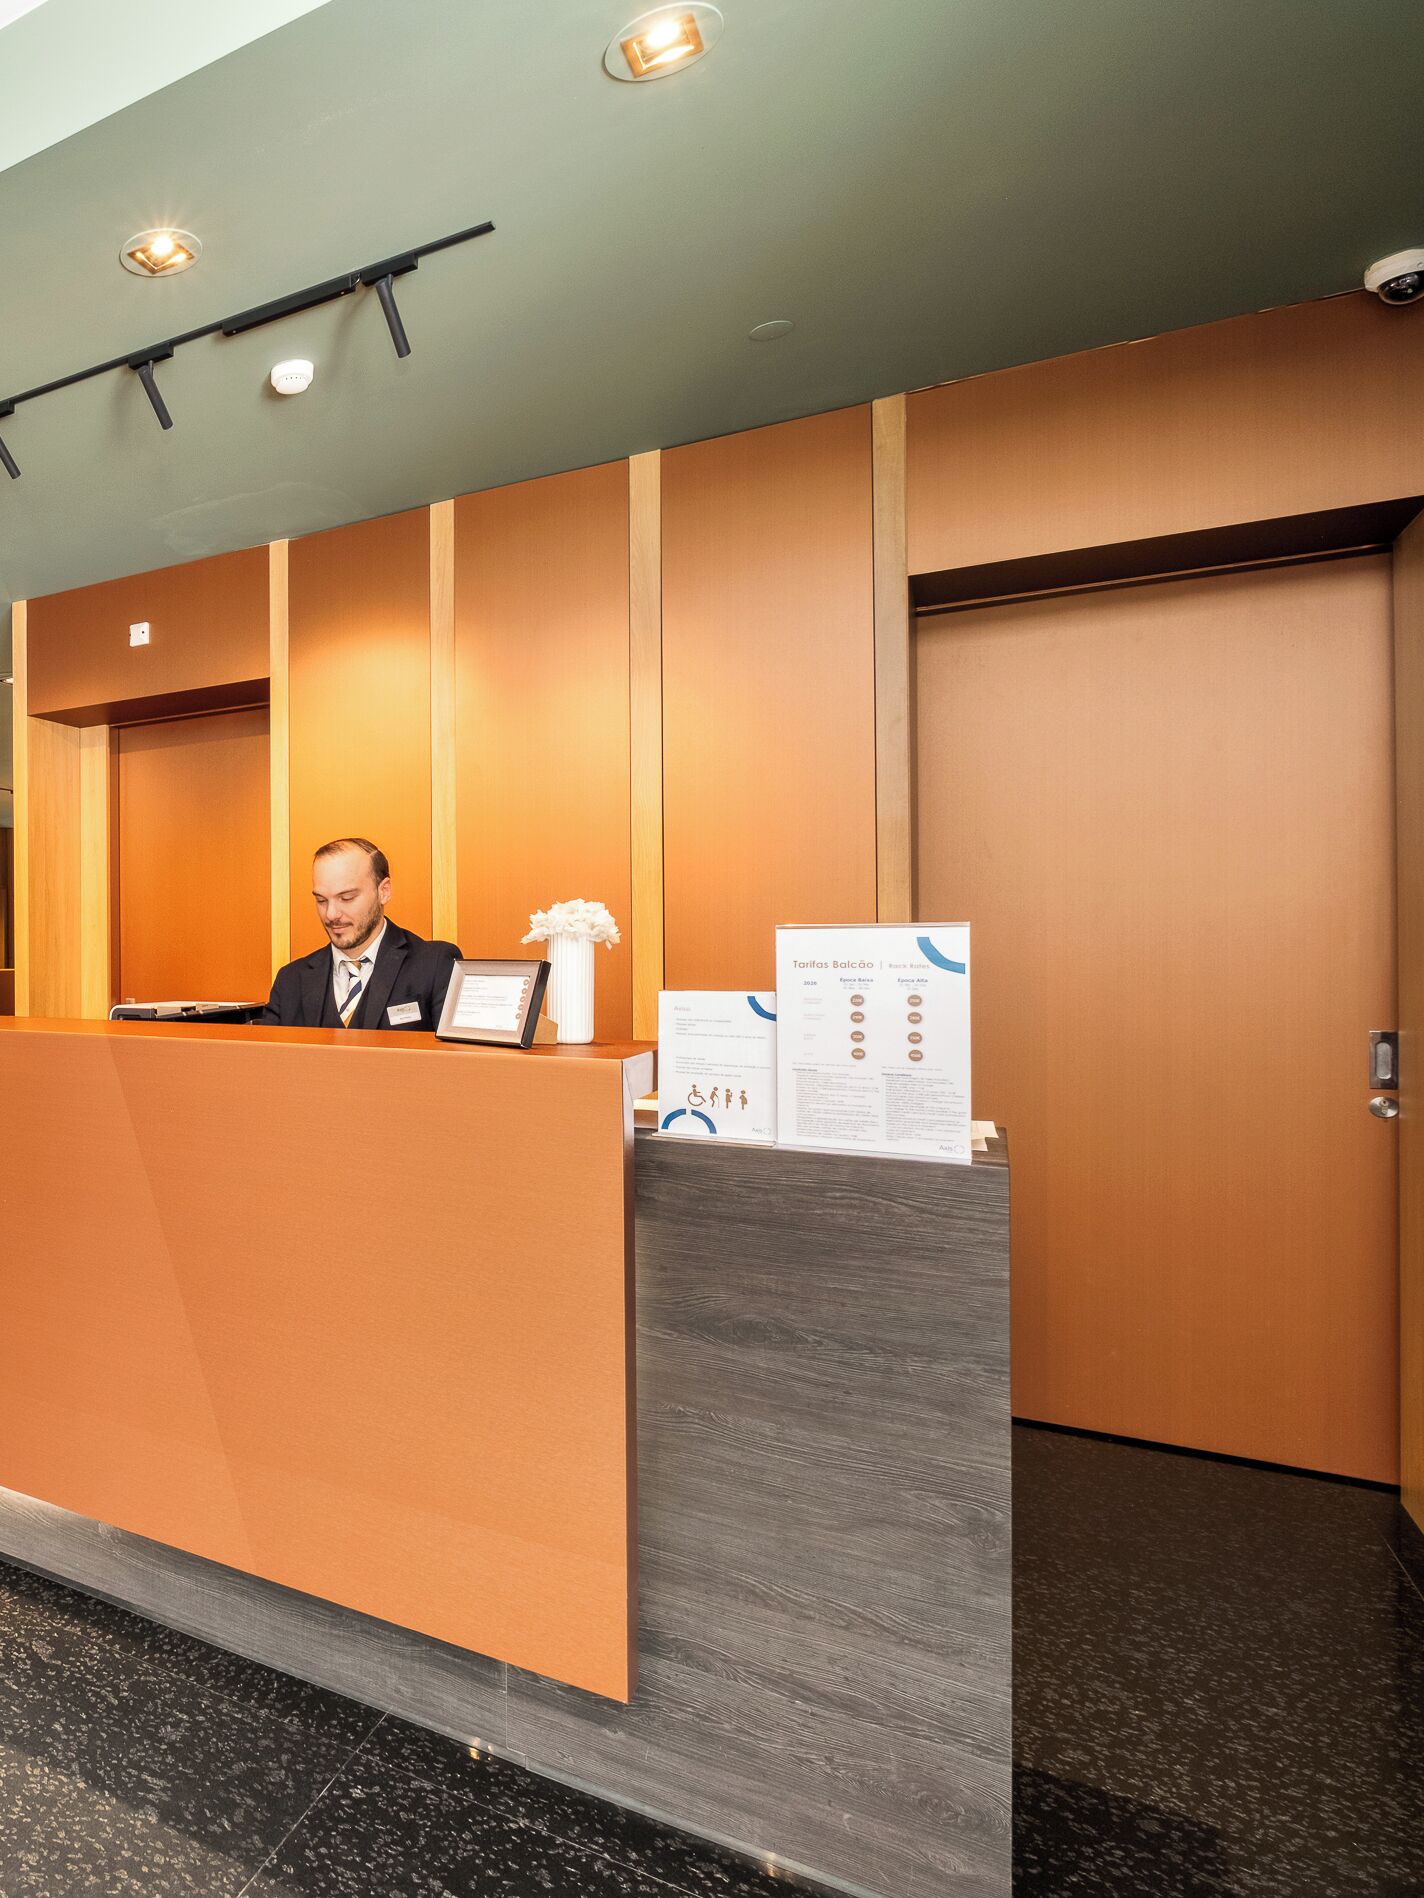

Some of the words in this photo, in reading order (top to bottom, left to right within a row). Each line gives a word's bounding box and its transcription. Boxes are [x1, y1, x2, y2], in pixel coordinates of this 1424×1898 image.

[792, 960, 829, 969] Tarifas
[832, 959, 874, 969] Balcão
[938, 1144, 954, 1152] Axis
